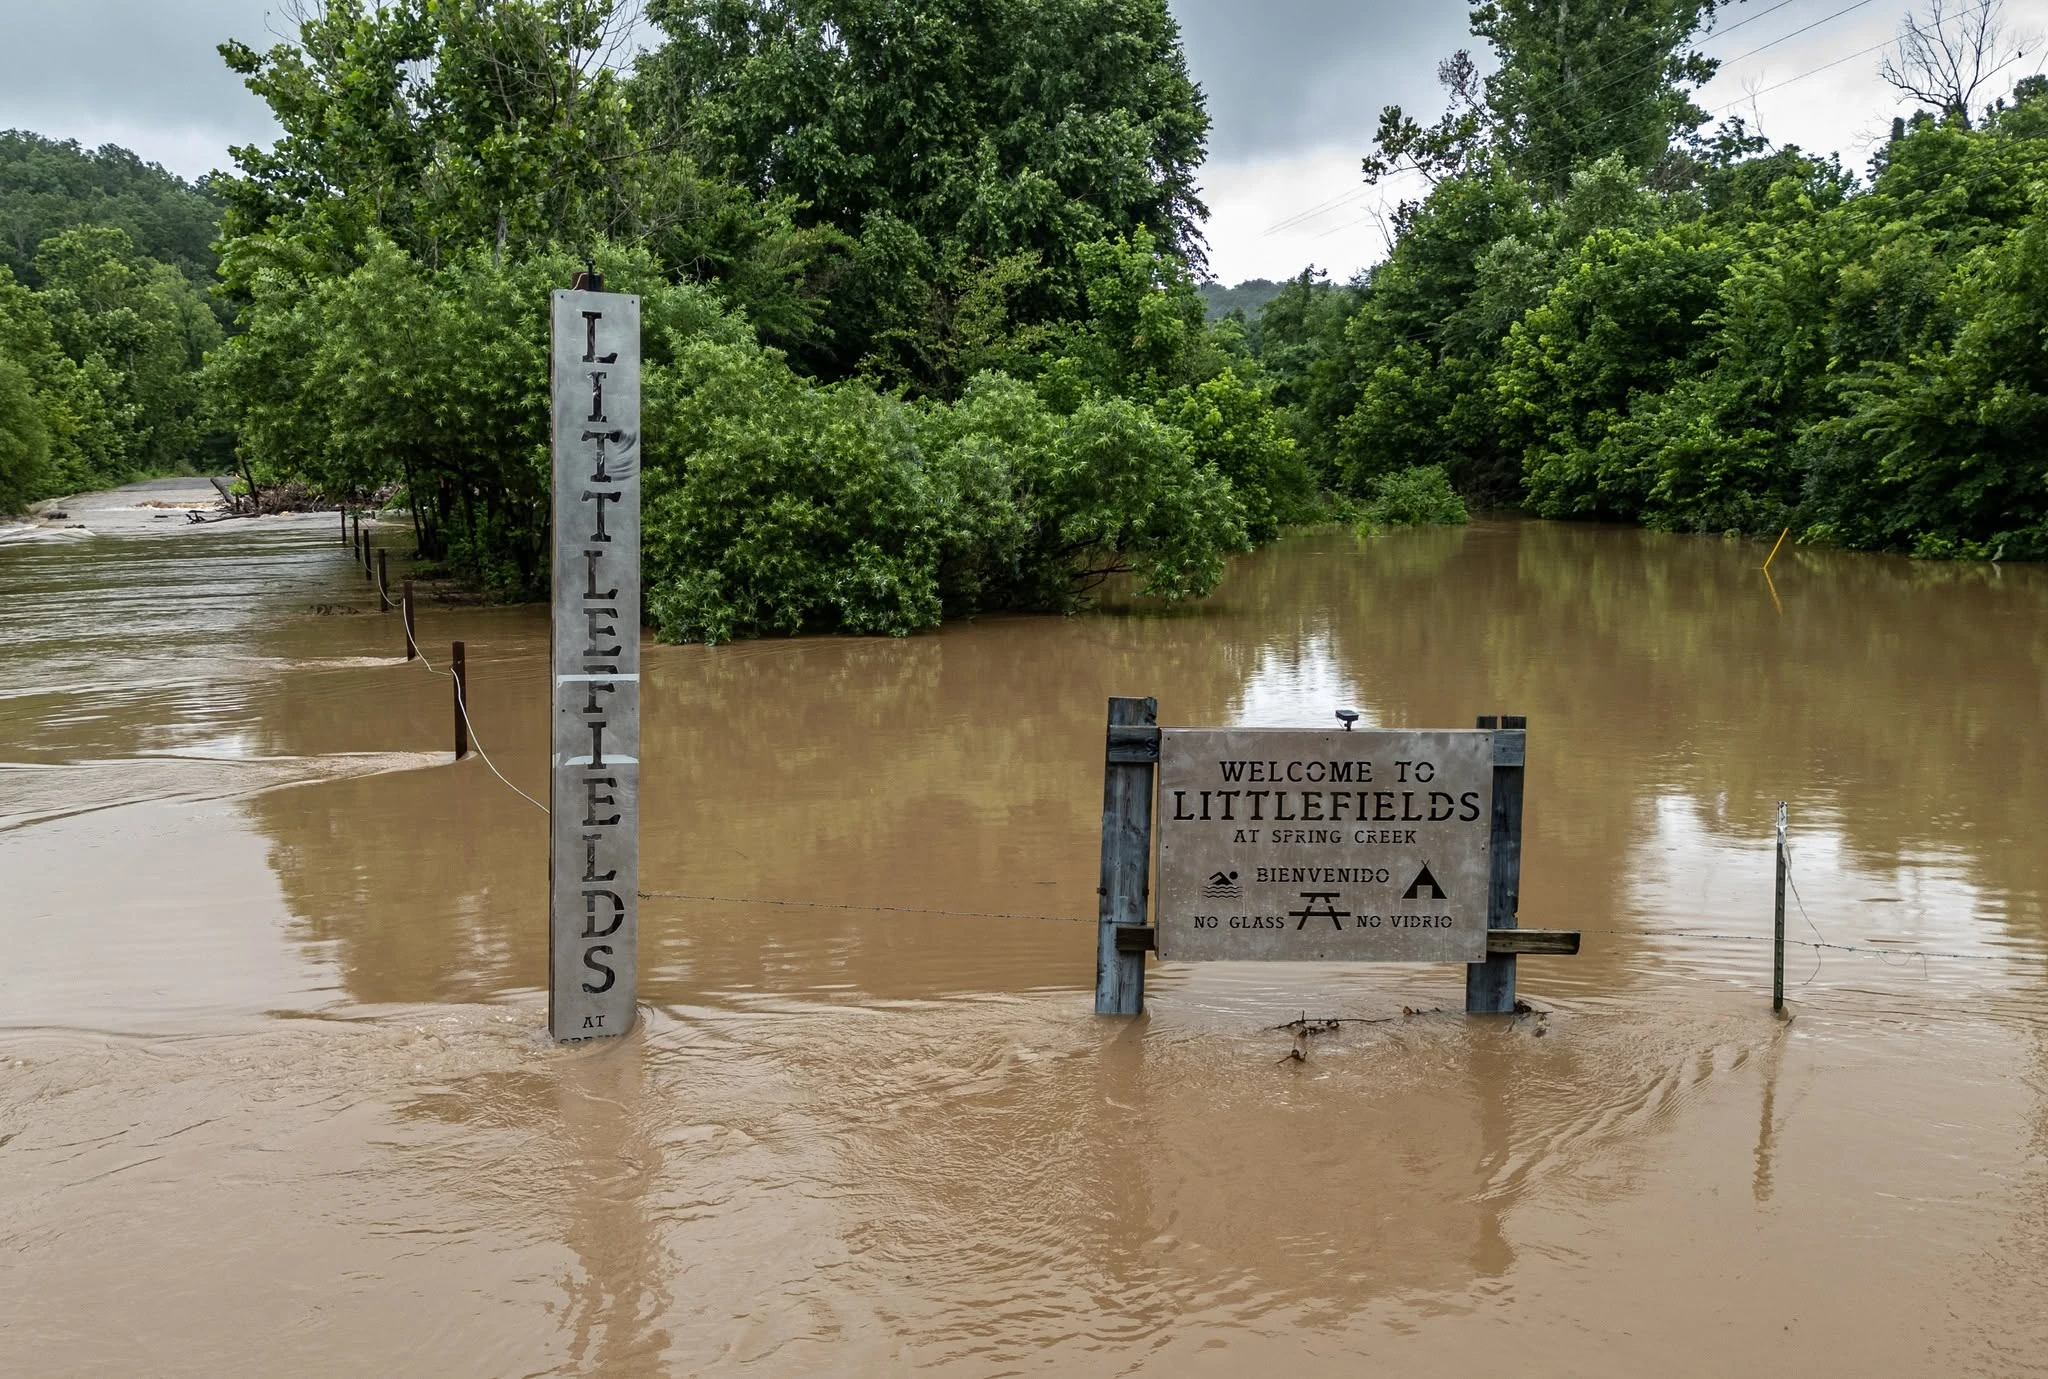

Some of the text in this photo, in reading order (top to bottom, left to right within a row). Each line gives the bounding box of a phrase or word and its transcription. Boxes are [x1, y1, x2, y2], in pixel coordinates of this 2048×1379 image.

[581, 311, 624, 994] LITTLEFIELDS
[1219, 761, 1435, 783] WELCOME TO
[1173, 791, 1480, 822] LITTLEFIELDS
[1233, 829, 1417, 844] AT SPRING CREEK
[1256, 867, 1390, 883] BIENVENIDO
[1194, 916, 1285, 930] NO GLASS
[1357, 915, 1453, 929] NO VIDRIO
[583, 1015, 605, 1028] AT
